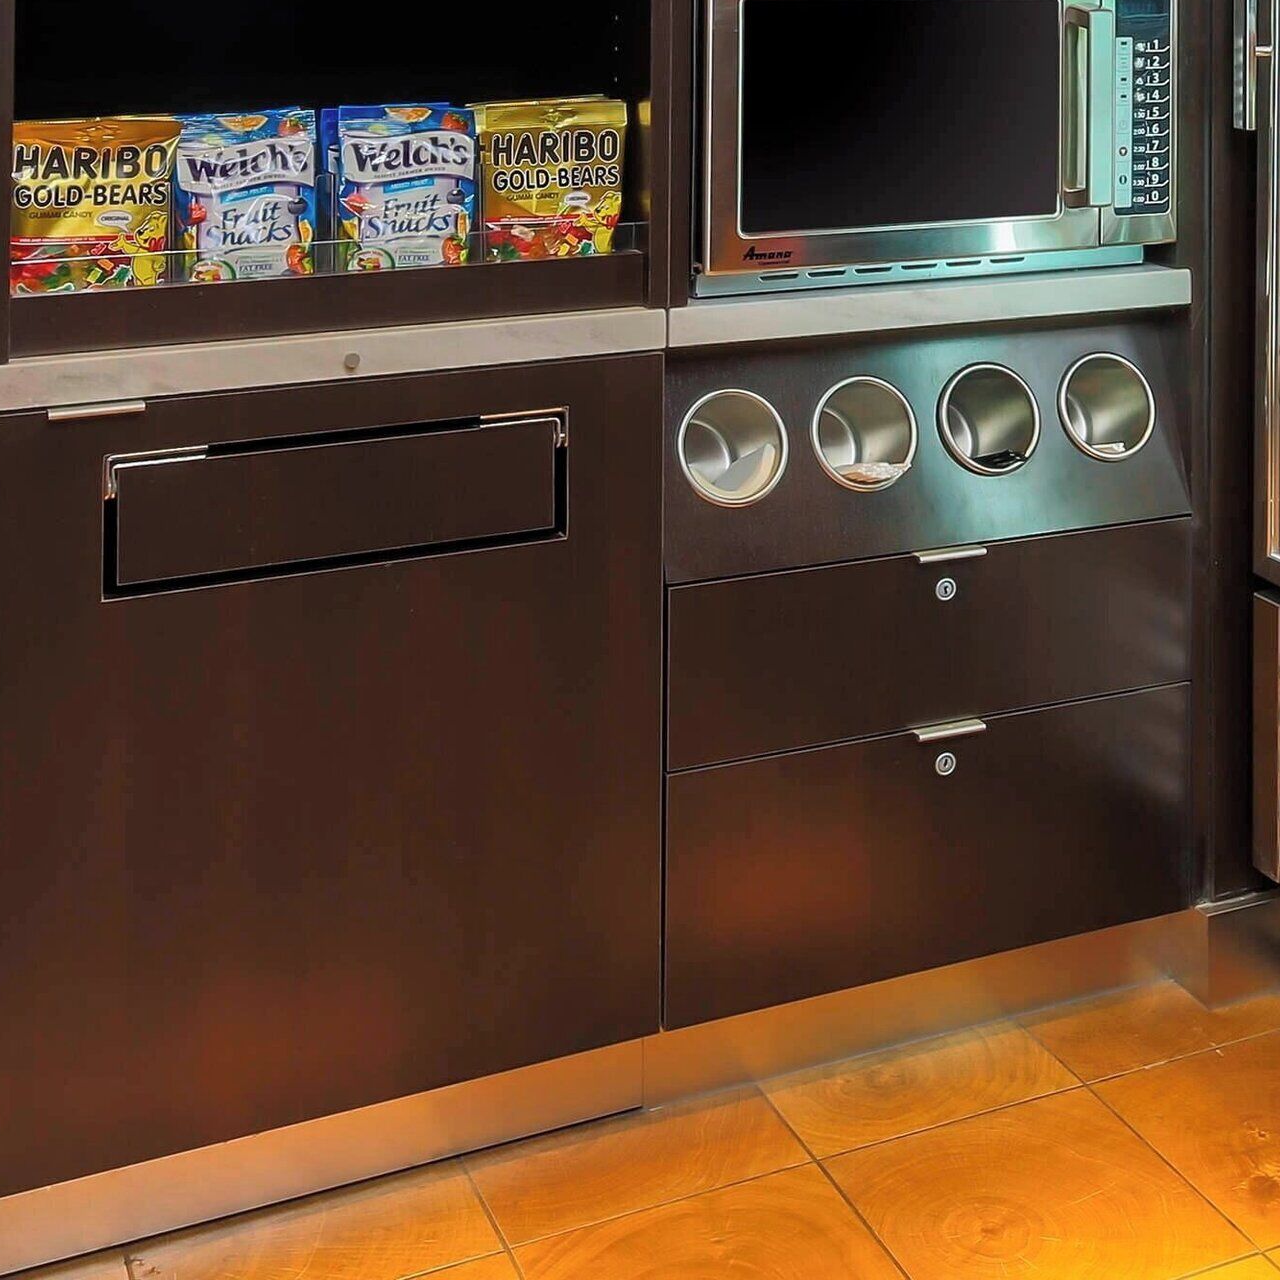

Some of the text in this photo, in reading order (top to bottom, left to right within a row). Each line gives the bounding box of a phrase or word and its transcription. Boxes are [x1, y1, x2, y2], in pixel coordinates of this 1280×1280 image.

[1153, 39, 1160, 50] 1
[1152, 55, 1160, 67] 2
[1152, 72, 1160, 84] 3
[1152, 89, 1160, 101] 4
[1152, 106, 1160, 117] 5
[1152, 123, 1159, 134] 6
[492, 130, 619, 166] HARIBO
[1152, 140, 1159, 151] 7
[352, 136, 468, 174] Welch's
[12, 144, 169, 180] HARIBO
[187, 143, 308, 182] Welch's
[1152, 156, 1159, 168] 8
[493, 166, 619, 192] GOLD-BEARS
[1151, 173, 1159, 185] 9
[14, 183, 167, 208] GOLD-BEARS
[1151, 190, 1159, 202] 0
[383, 193, 441, 219] Fruit
[365, 211, 452, 239] Snacks
[206, 222, 293, 246] Snacks
